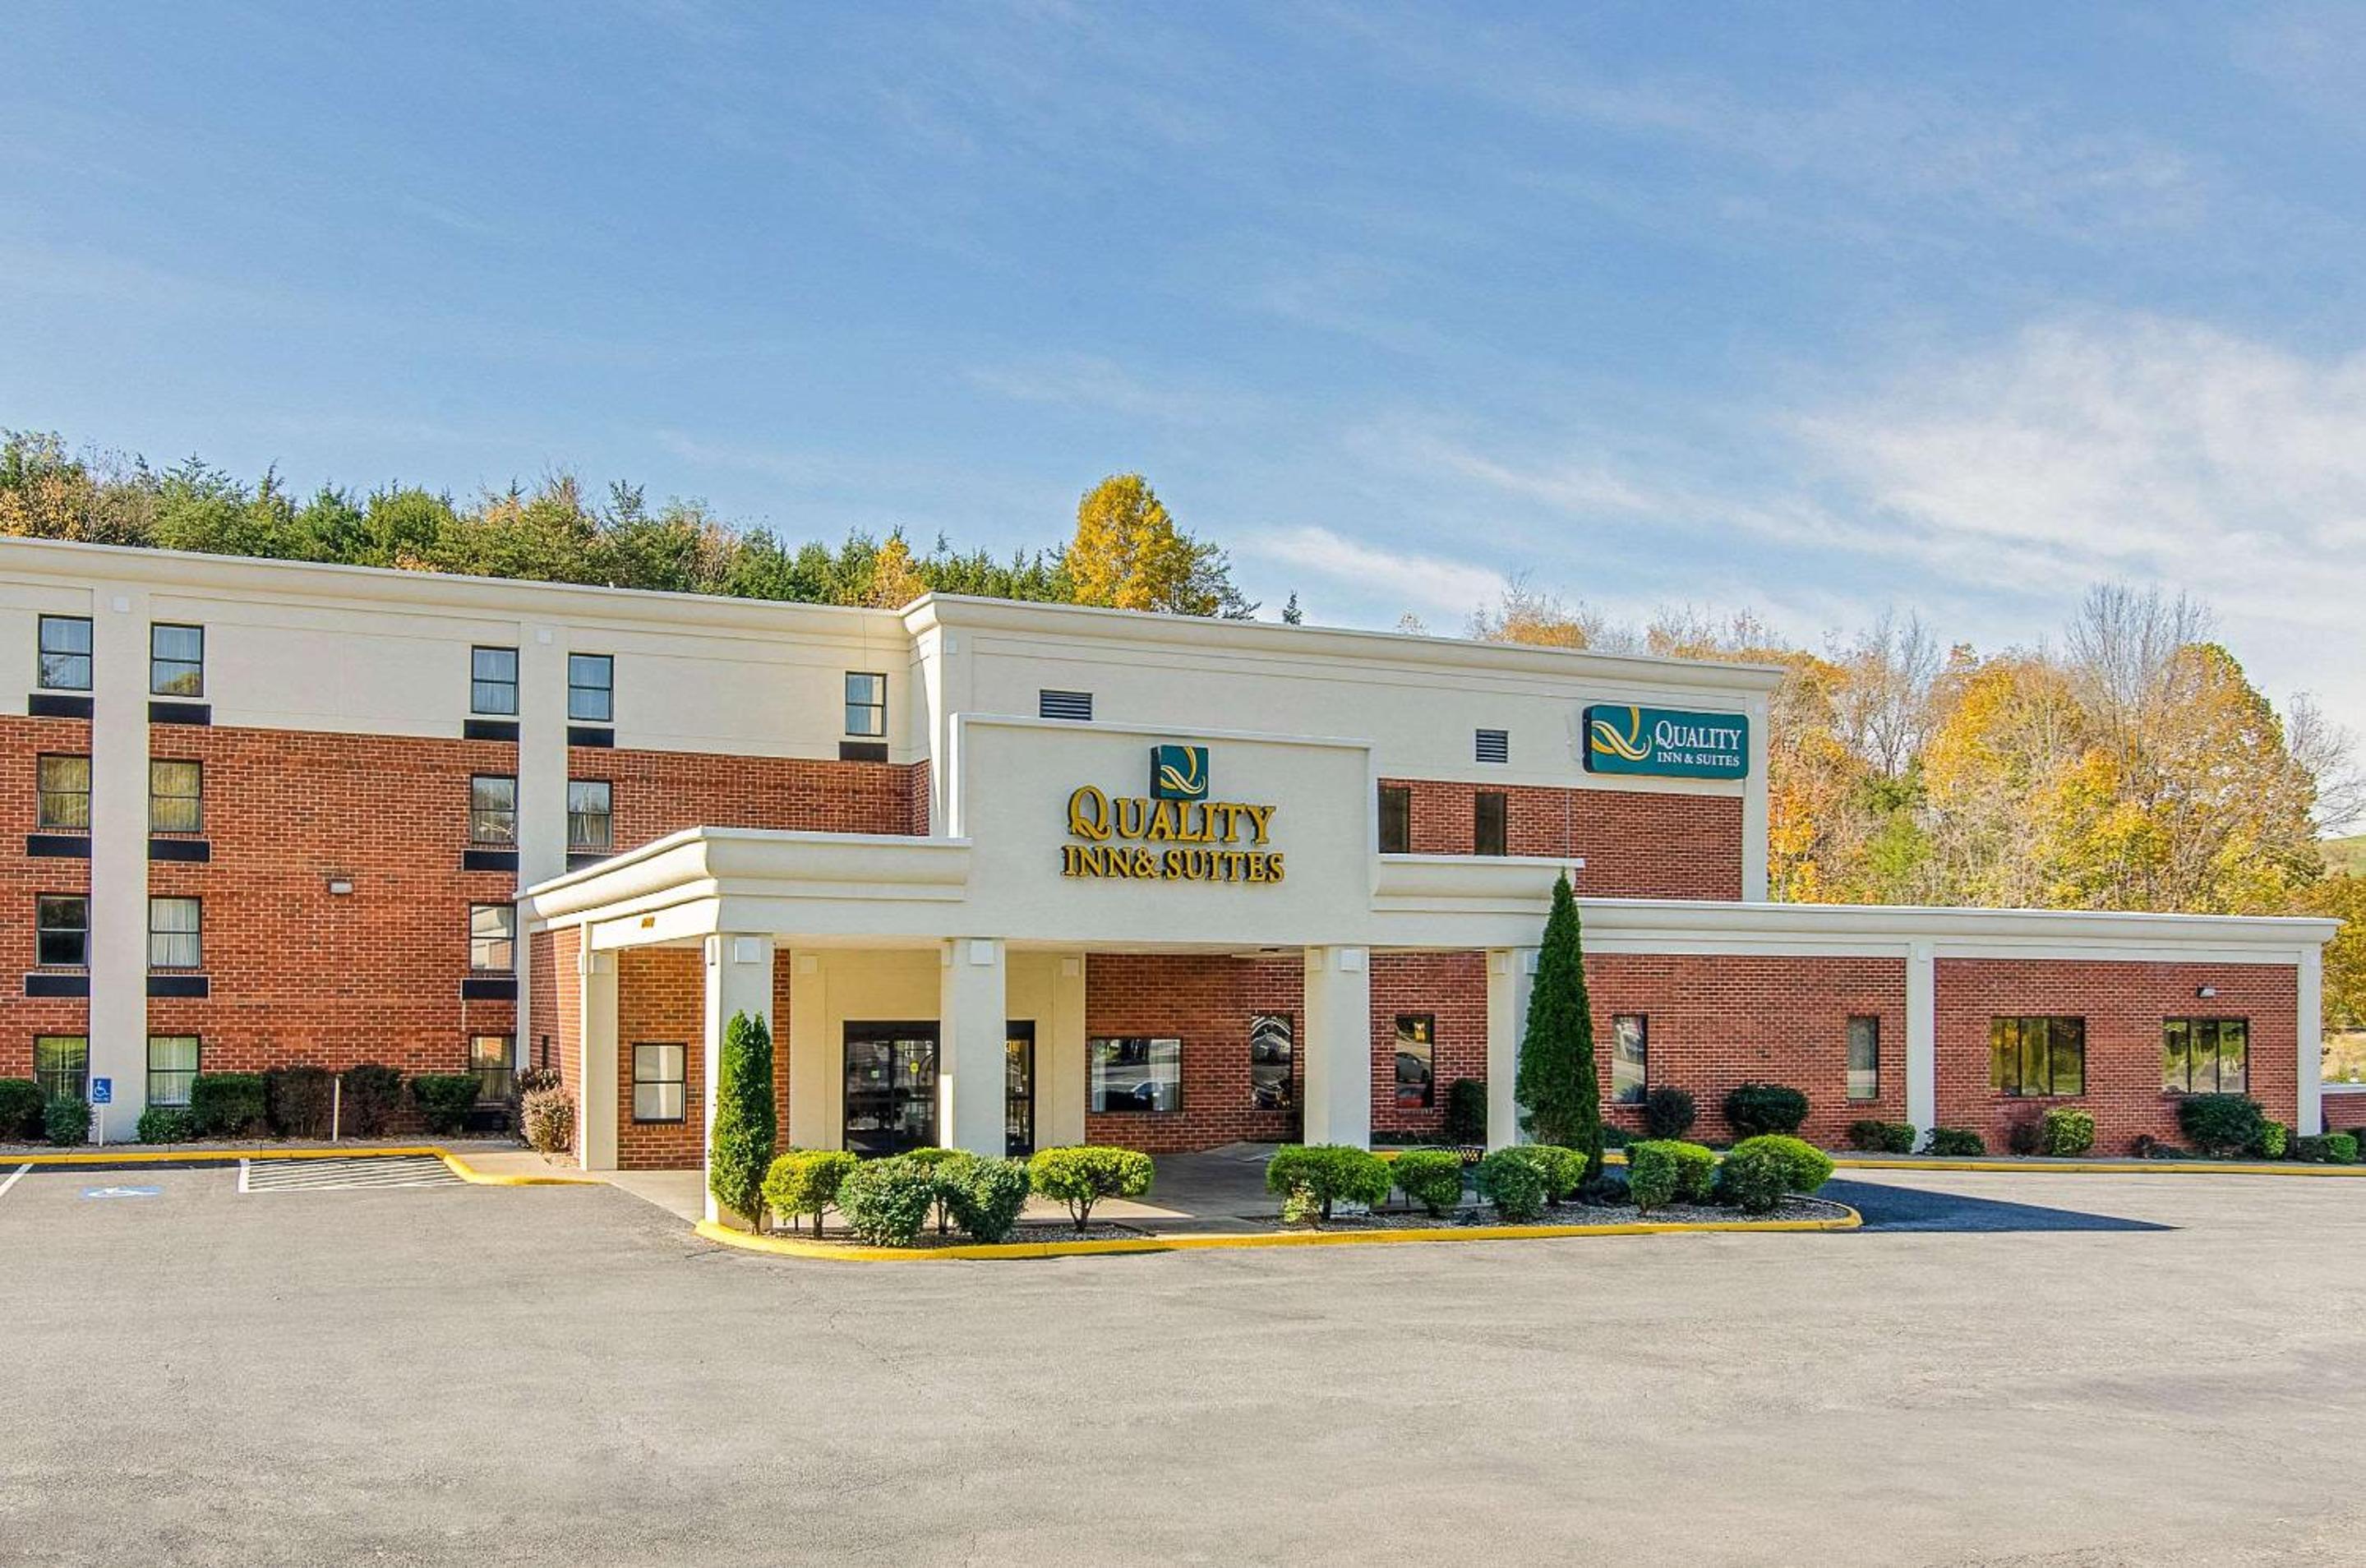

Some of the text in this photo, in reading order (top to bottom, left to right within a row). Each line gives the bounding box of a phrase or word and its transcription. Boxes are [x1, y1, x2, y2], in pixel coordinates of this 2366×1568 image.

[1655, 720, 1742, 749] QUALITY
[1657, 751, 1741, 768] INN & SUITES
[1068, 785, 1276, 845] QUALITY
